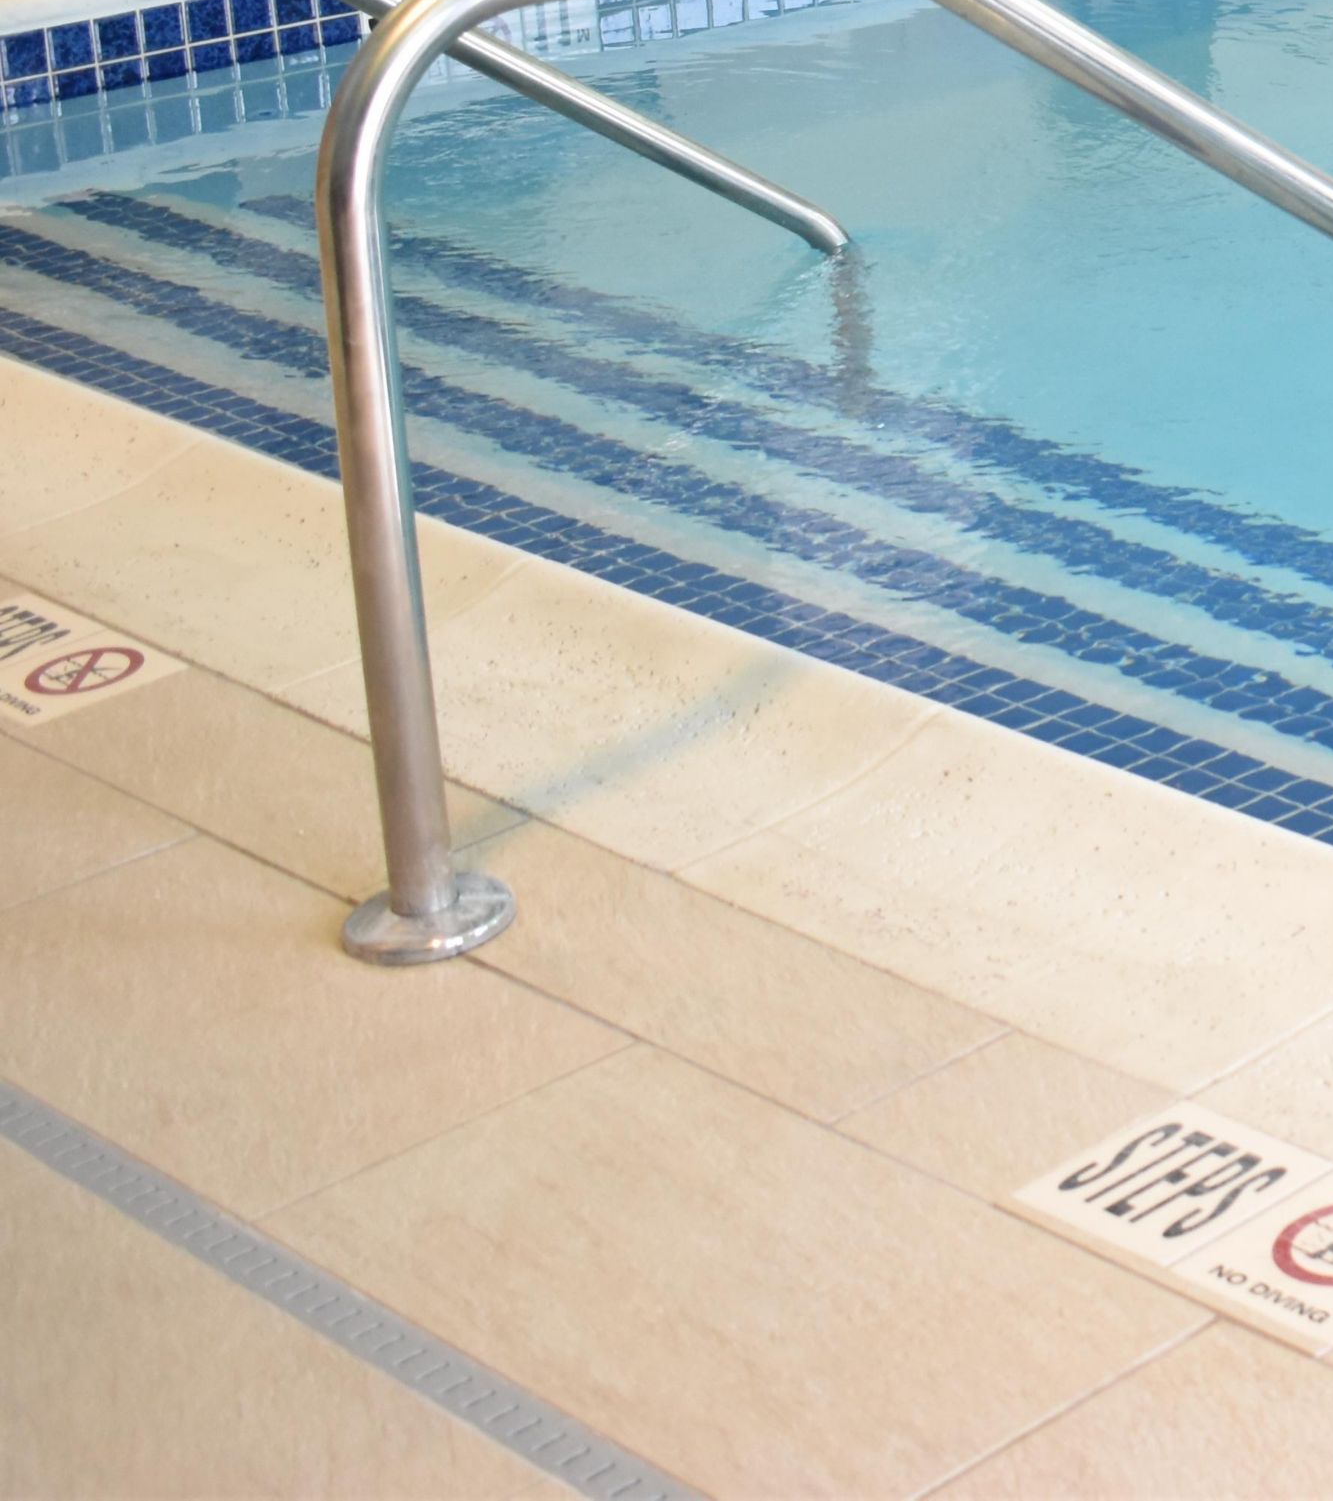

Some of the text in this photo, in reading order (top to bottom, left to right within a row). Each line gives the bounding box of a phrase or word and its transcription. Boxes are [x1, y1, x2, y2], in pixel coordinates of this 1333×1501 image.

[1058, 1122, 1288, 1239] STEPS
[1208, 1264, 1331, 1323] NO DIVING
